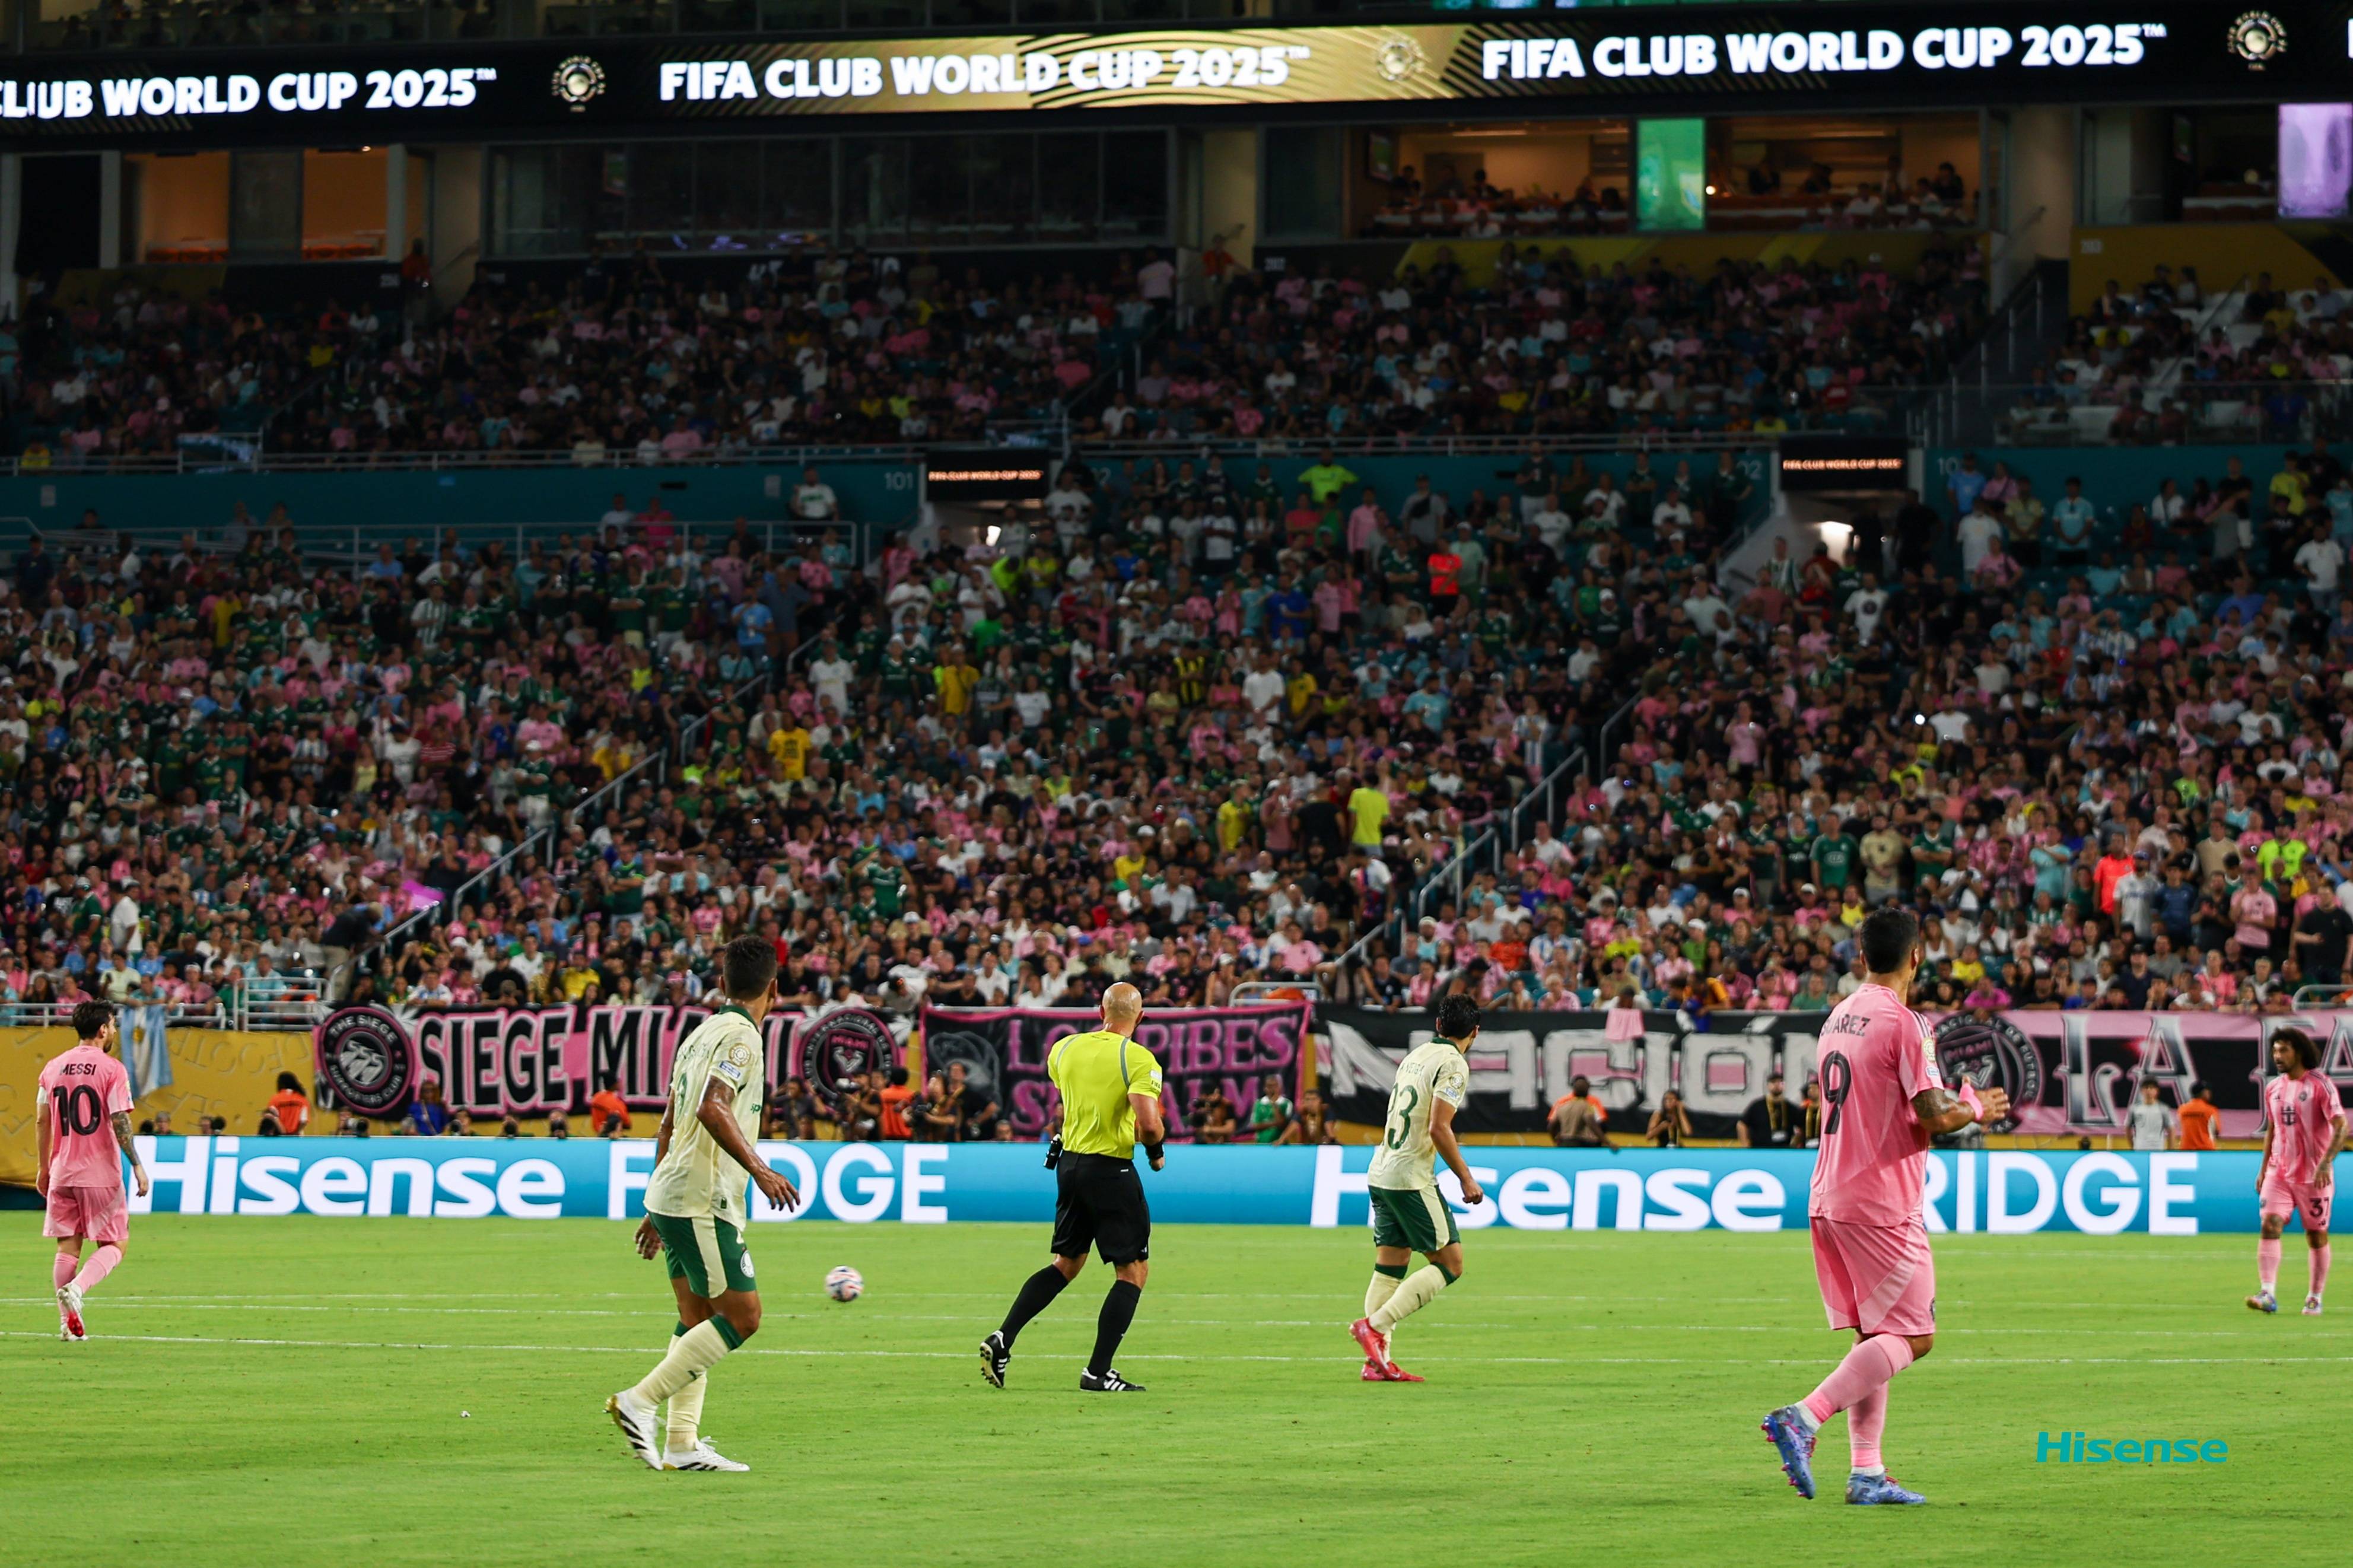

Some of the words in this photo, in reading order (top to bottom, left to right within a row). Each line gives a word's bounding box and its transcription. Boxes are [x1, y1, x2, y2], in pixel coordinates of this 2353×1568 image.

[660, 61, 758, 101] FIFA
[764, 58, 883, 99] CLUB
[890, 53, 1060, 96] WORLD
[1068, 50, 1163, 90] CUP
[1483, 39, 1586, 79] FIFA
[1593, 34, 1718, 77] CLUB
[1725, 30, 1904, 74] WORLD
[1913, 27, 2013, 69] CUP
[0, 80, 93, 119] LUB
[100, 75, 260, 116] WORLD
[268, 72, 358, 112] CUP
[884, 472, 914, 491] 101
[328, 1015, 356, 1037] THE
[357, 1014, 398, 1045] SIEGE
[61, 1063, 97, 1076] MESSI
[417, 1009, 574, 1108] SIEGE
[2053, 1013, 2199, 1127] LA
[53, 1084, 101, 1137] 10
[1822, 1050, 1852, 1135] 9
[128, 1135, 565, 1219] Hisense
[608, 1140, 949, 1223] FDGE
[1310, 1144, 1786, 1232] Hsense
[1922, 1150, 2199, 1235] RIDGE
